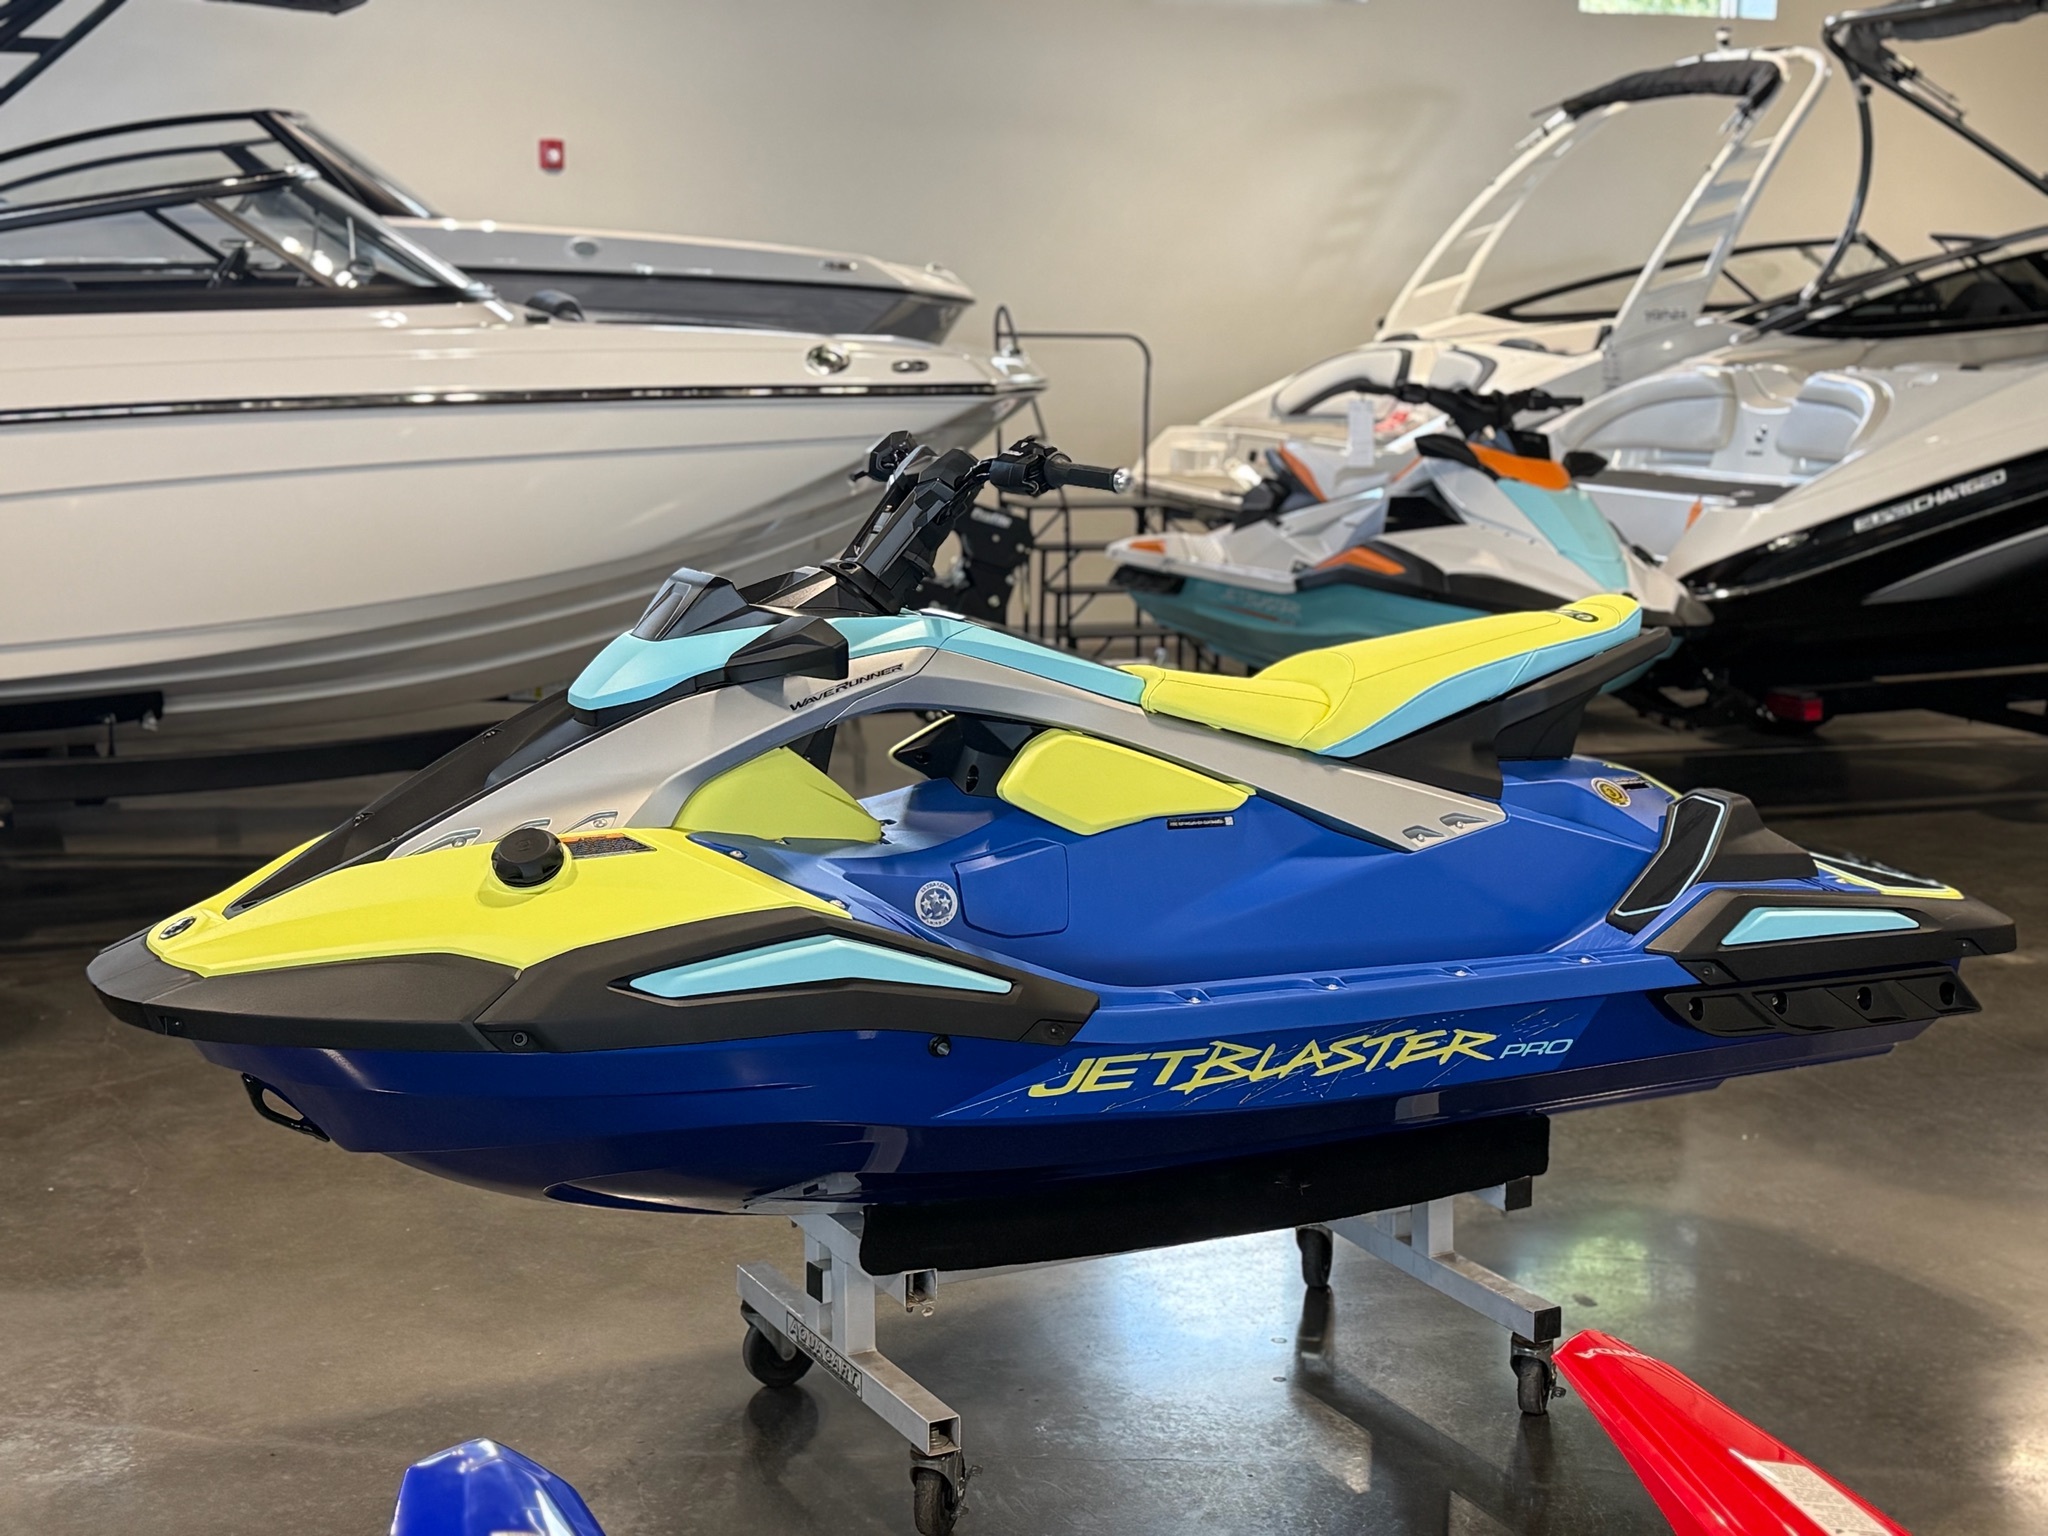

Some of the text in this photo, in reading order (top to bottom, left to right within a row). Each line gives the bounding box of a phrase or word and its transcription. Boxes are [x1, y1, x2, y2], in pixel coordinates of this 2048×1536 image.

[789, 663, 904, 712] WAVERUNNER
[1028, 1028, 1574, 1098] JETBLASTER PRO
